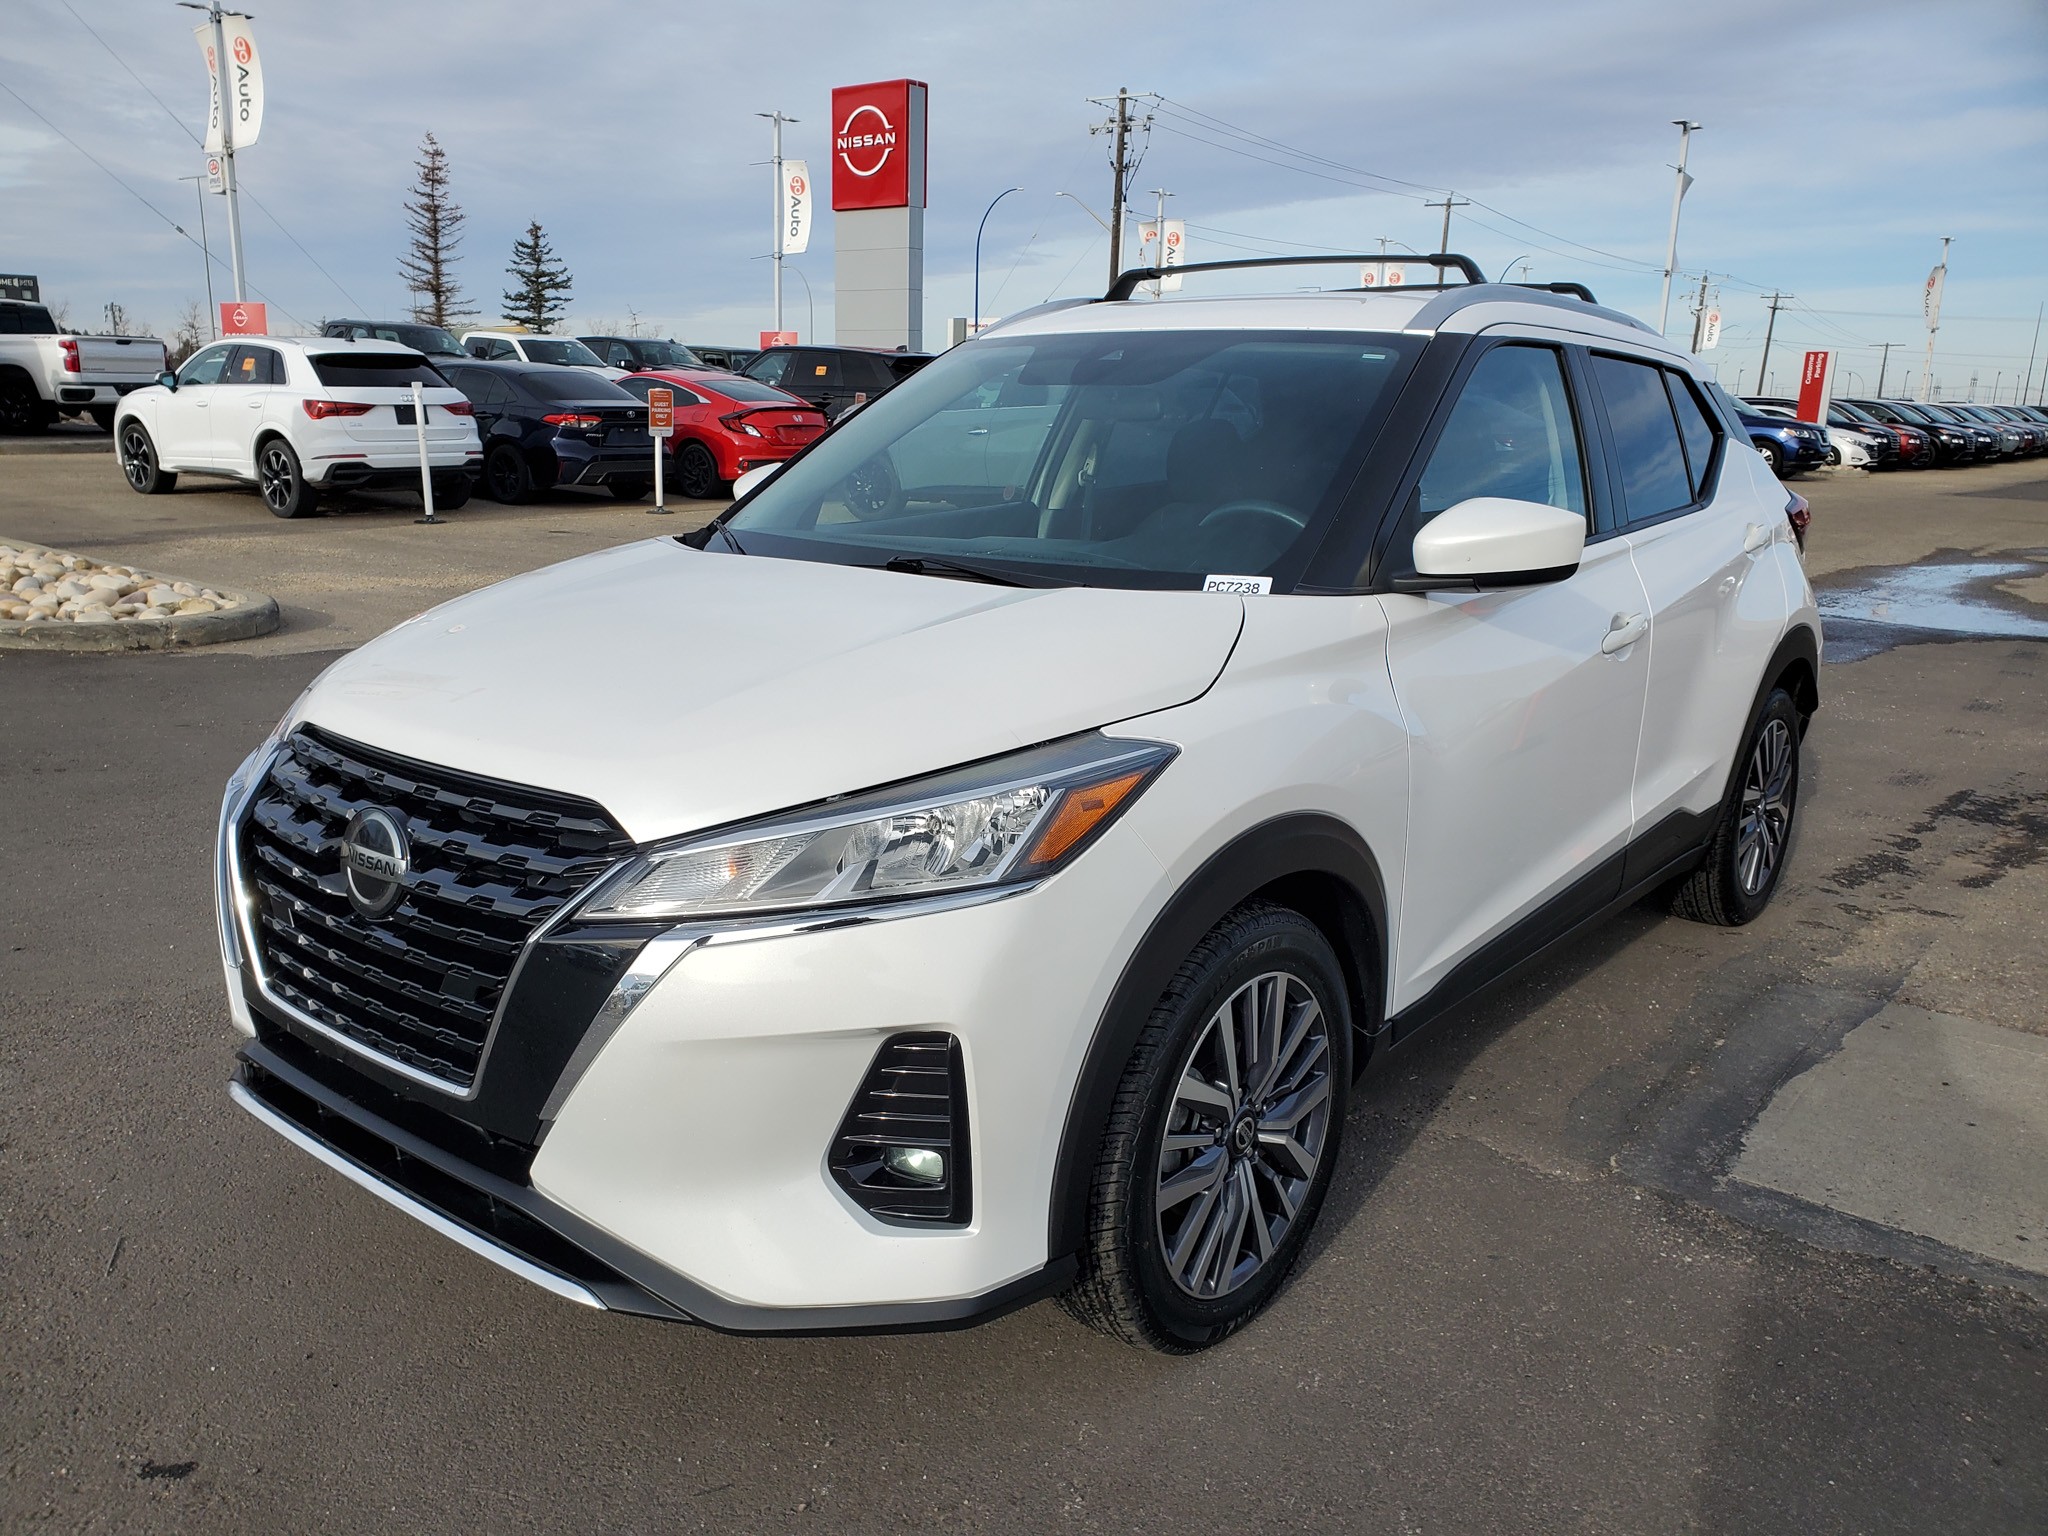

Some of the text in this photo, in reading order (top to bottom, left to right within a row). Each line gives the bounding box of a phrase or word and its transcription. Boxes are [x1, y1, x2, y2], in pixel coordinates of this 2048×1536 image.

[837, 132, 896, 149] NISSAN
[1805, 353, 1815, 385] Customer
[1814, 353, 1825, 379] Parking
[1207, 581, 1260, 595] PC7238
[348, 844, 396, 877] NISSAN
